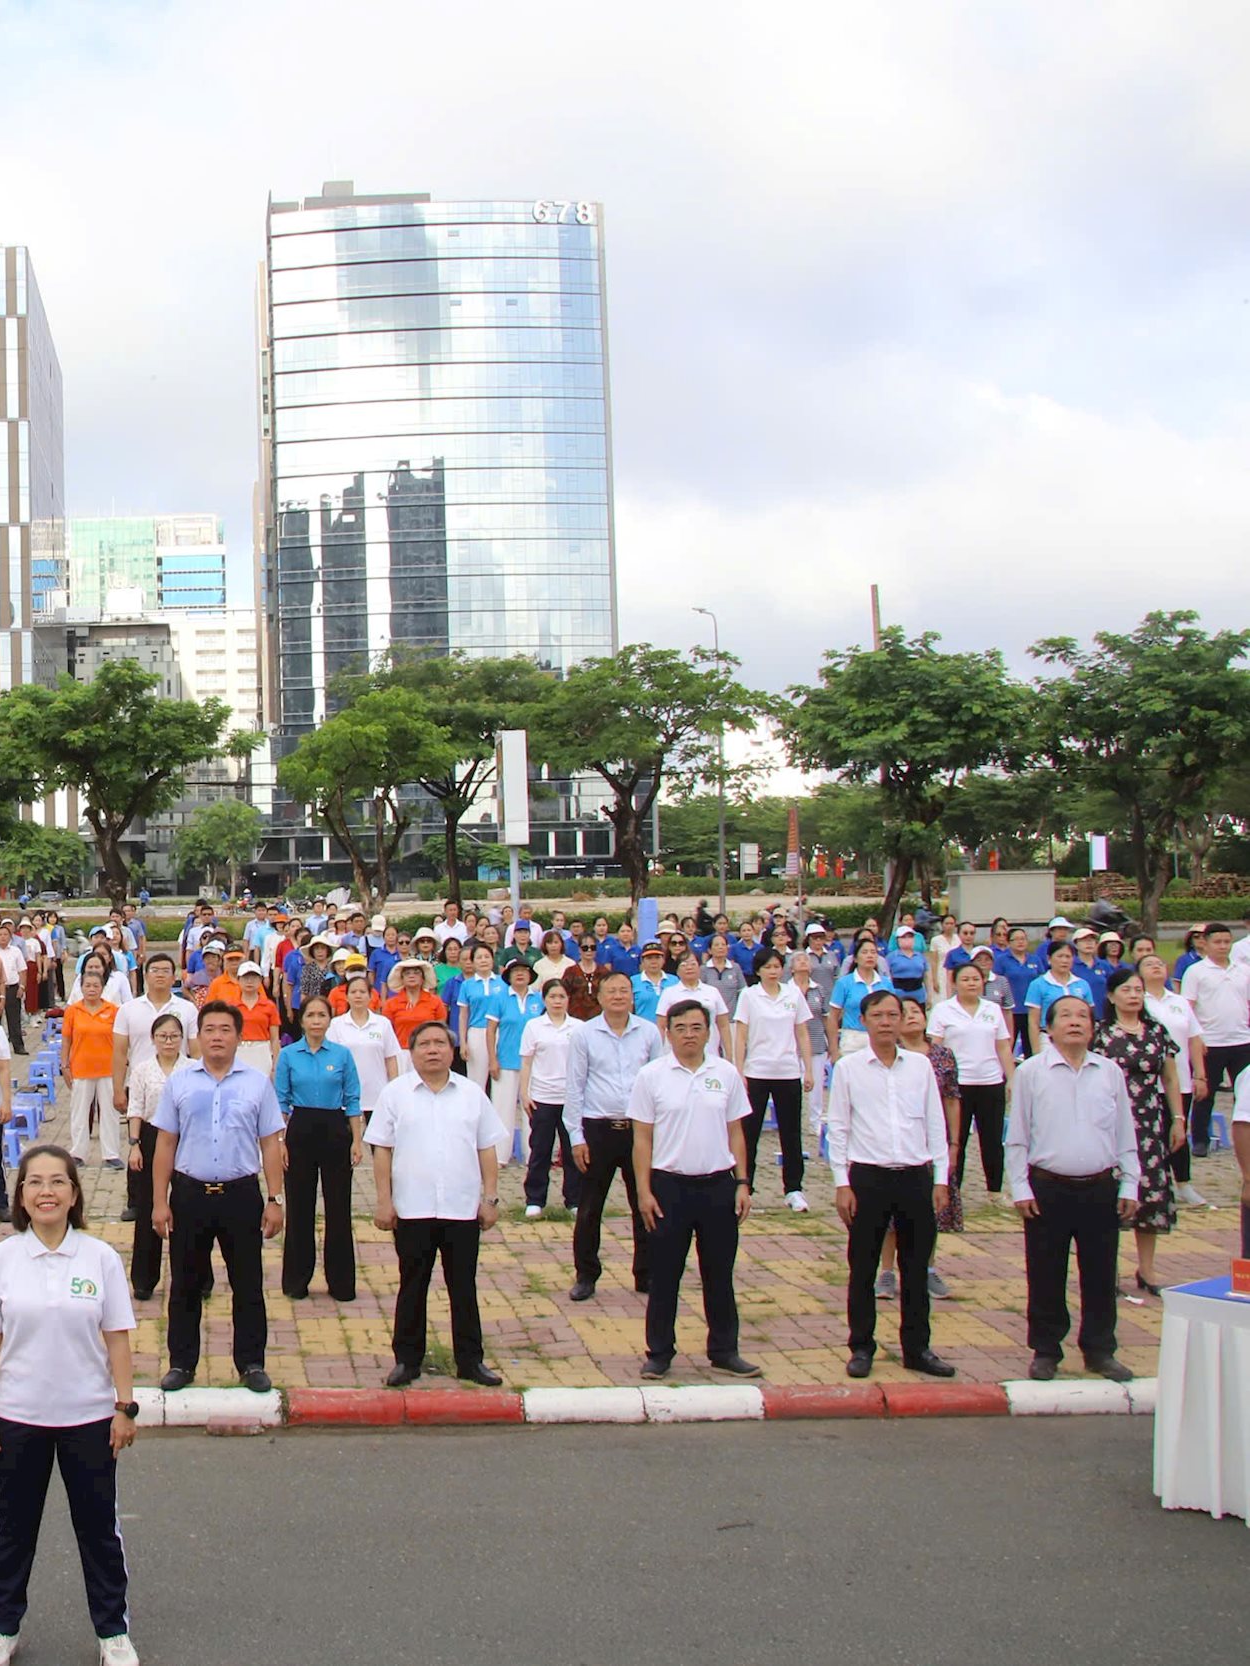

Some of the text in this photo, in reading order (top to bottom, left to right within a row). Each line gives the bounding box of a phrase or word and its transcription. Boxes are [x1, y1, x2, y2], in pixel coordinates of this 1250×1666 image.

[532, 200, 594, 224] 678
[705, 1078, 721, 1089] 50
[70, 1277, 97, 1296] 50
